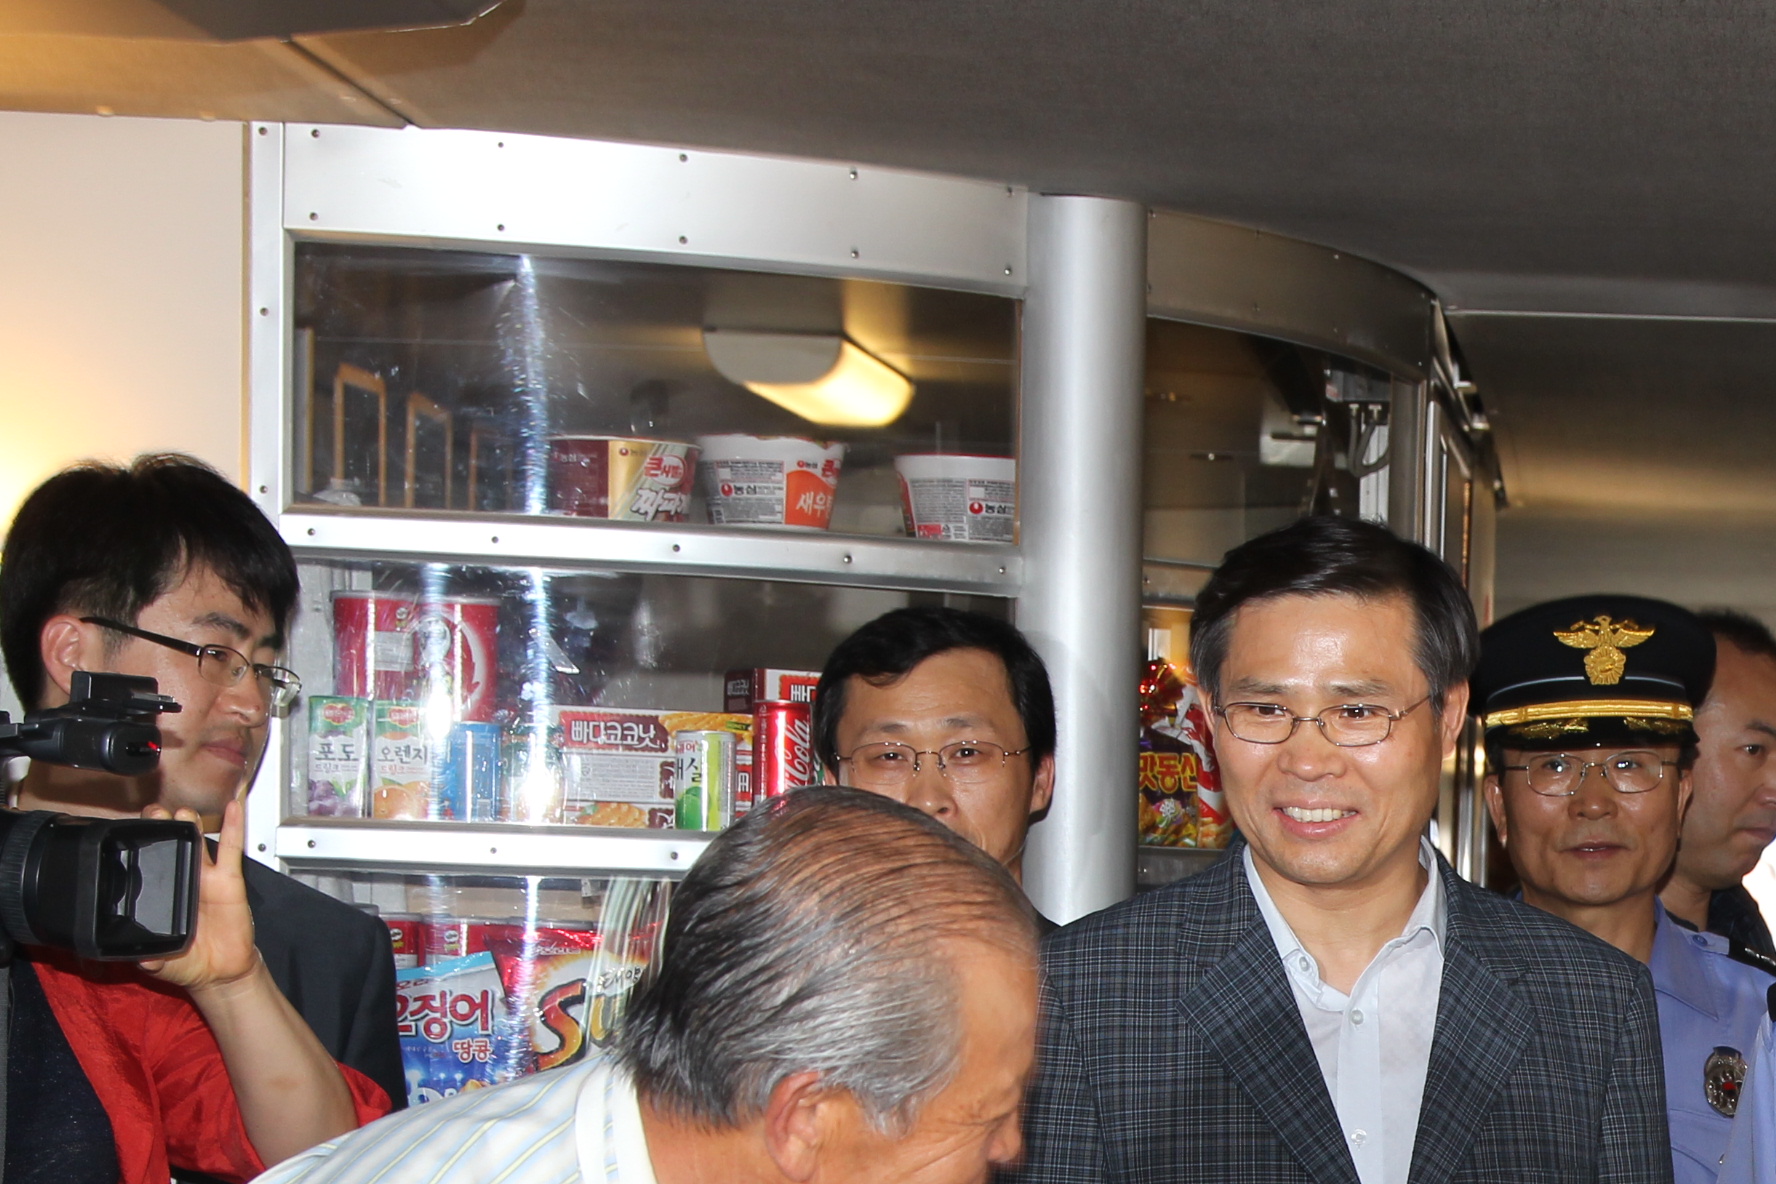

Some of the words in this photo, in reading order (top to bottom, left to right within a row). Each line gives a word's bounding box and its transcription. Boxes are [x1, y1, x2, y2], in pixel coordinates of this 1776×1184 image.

[734, 484, 757, 496] 농심
[985, 503, 1007, 515] 농심
[571, 719, 660, 749] 빠다코코낫
[315, 743, 360, 762] 포도
[377, 743, 429, 765] 오렌지
[454, 1037, 490, 1063] 땅콩
